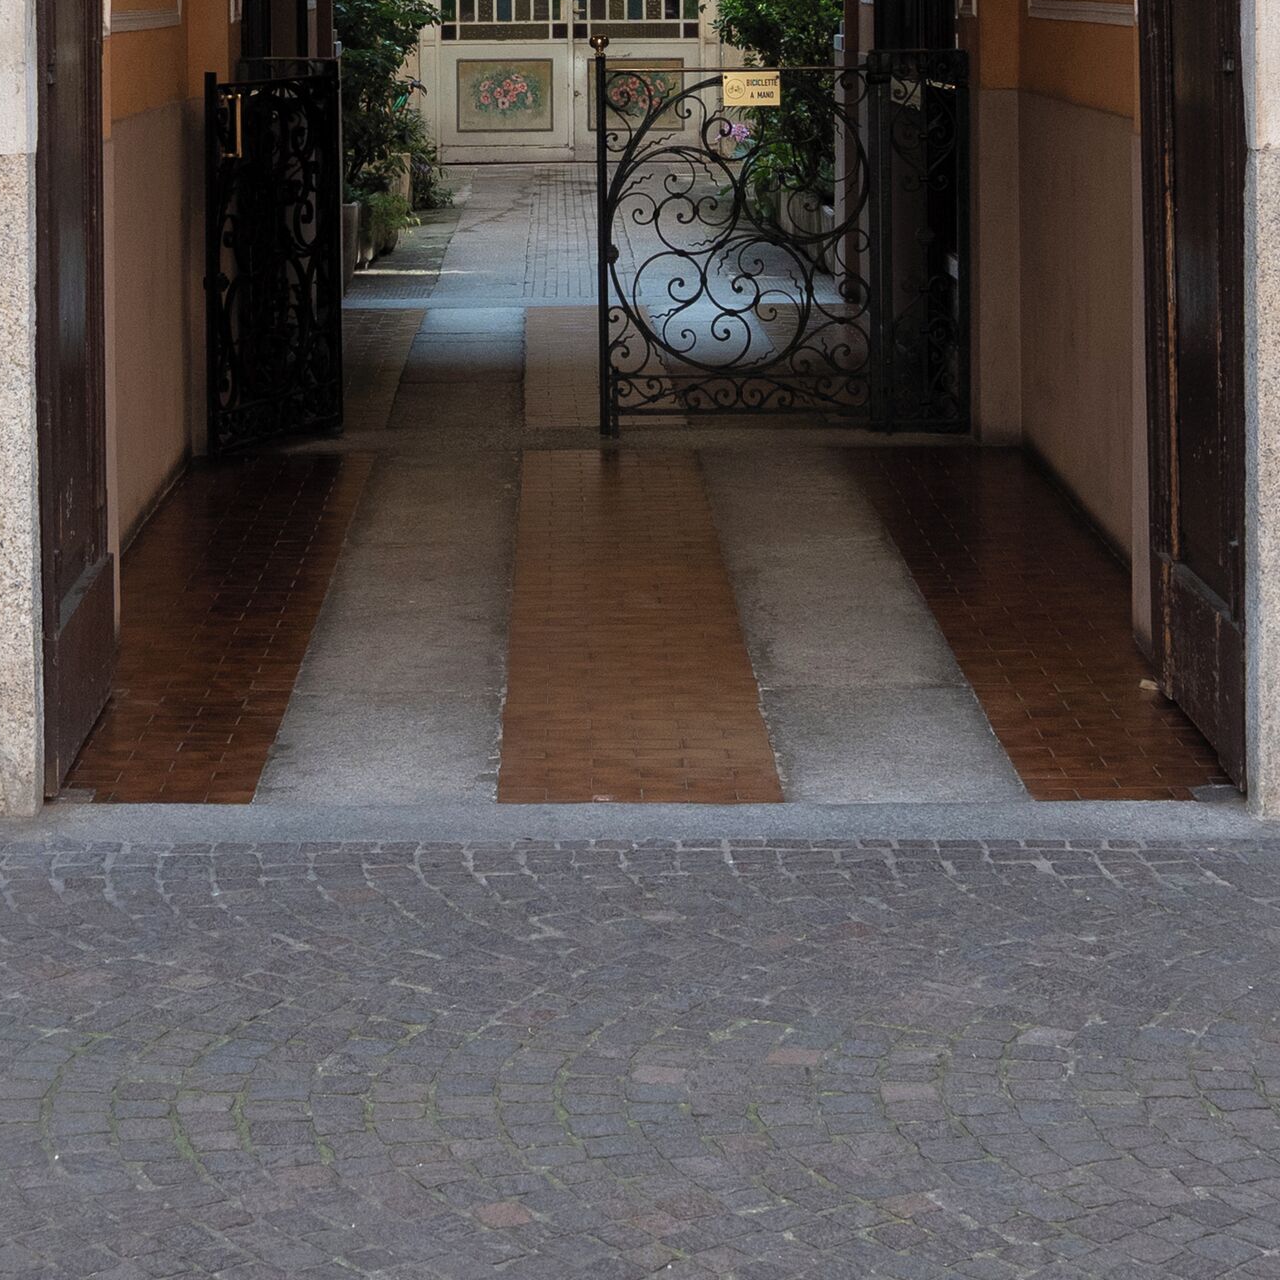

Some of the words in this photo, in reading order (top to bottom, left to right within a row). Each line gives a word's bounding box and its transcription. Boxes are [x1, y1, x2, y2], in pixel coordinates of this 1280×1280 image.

[746, 79, 778, 87] BICICLETTE
[750, 91, 755, 99] A
[757, 91, 774, 99] MANO
